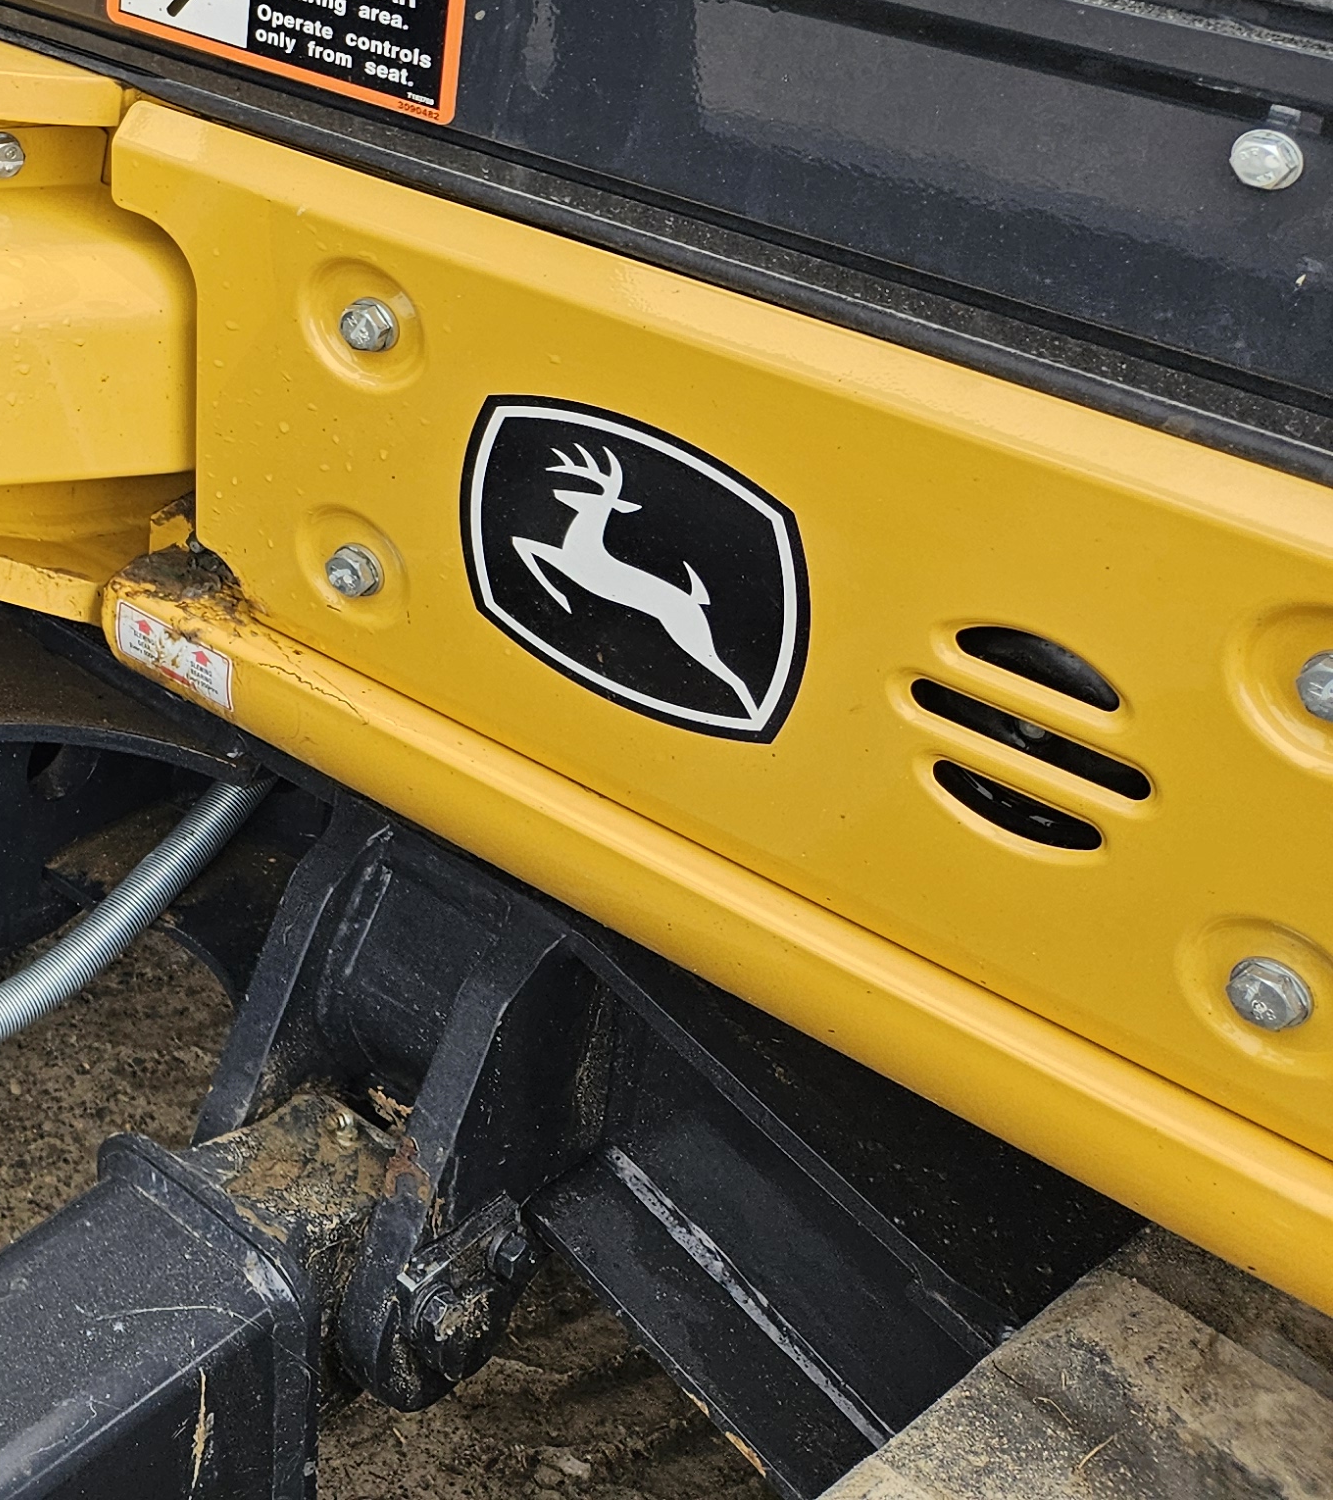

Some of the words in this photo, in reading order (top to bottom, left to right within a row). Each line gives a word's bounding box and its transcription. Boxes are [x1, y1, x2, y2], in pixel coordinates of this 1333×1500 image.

[257, 4, 333, 41] Operate
[345, 32, 432, 68] controls
[358, 7, 410, 31] area.
[255, 29, 297, 55] only
[308, 40, 353, 69] from
[364, 59, 414, 87] seat.
